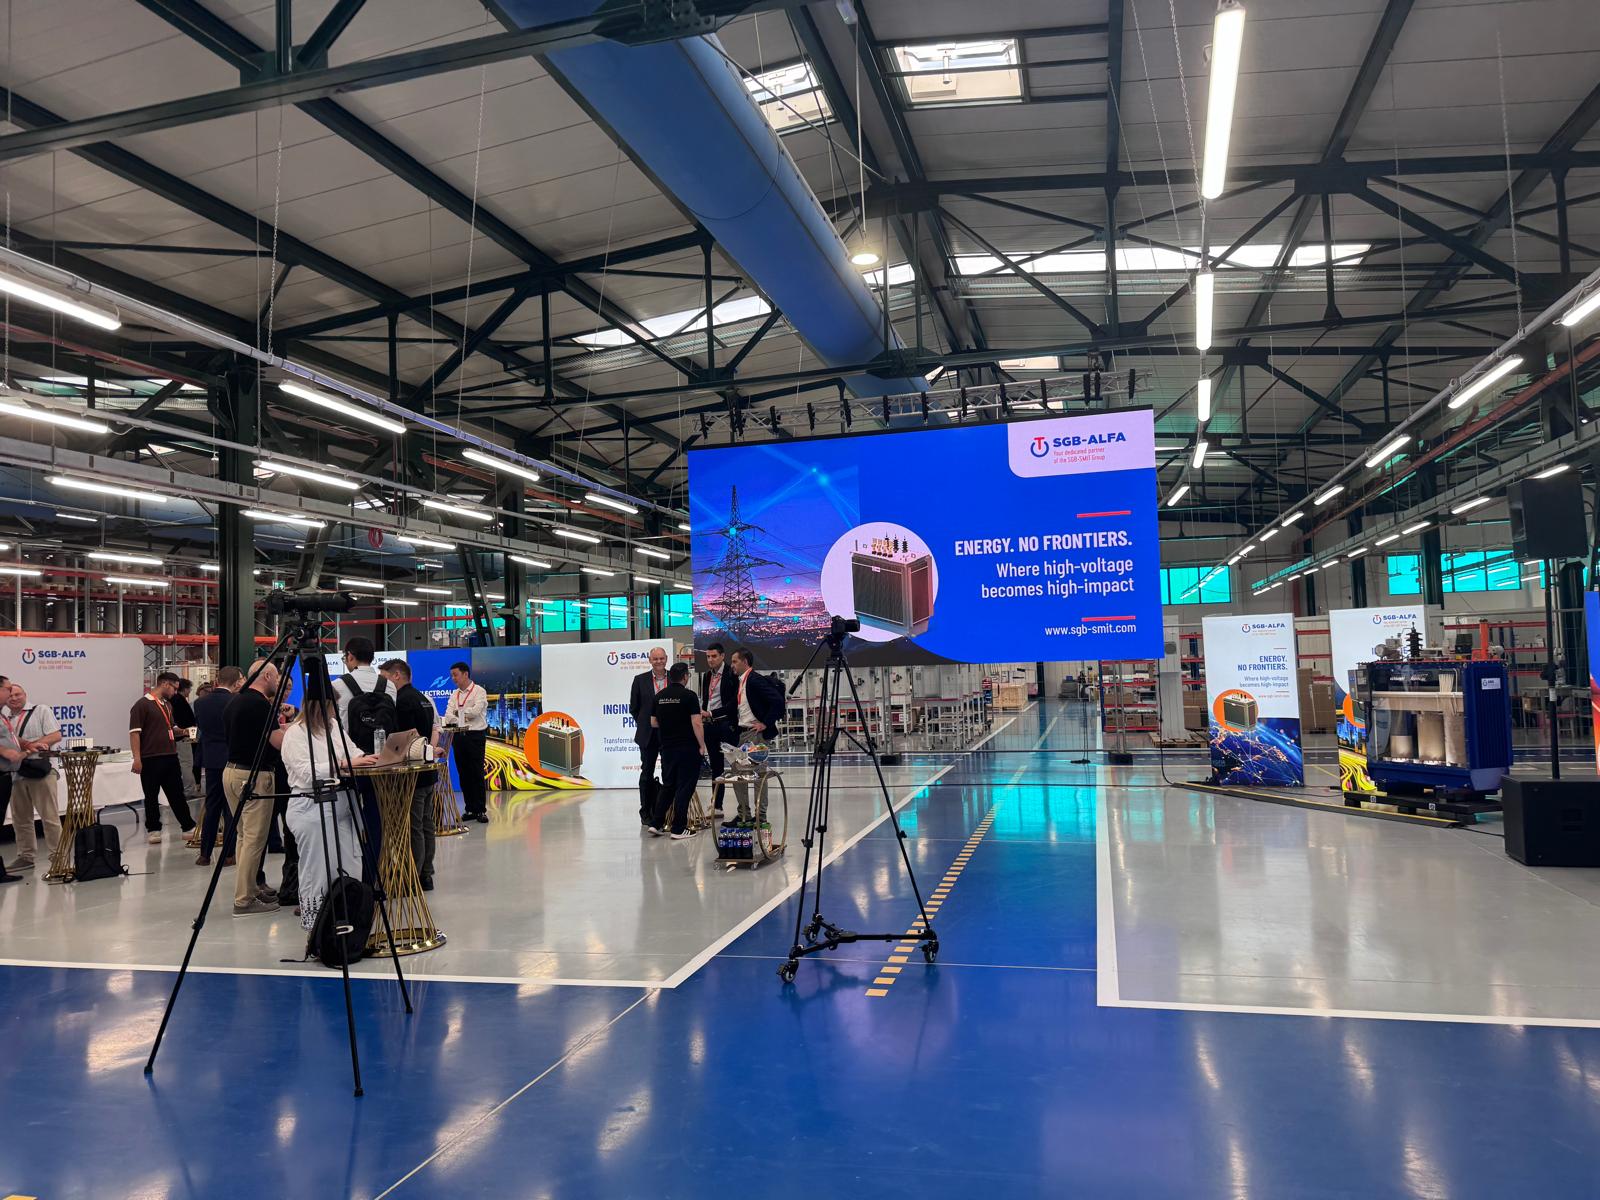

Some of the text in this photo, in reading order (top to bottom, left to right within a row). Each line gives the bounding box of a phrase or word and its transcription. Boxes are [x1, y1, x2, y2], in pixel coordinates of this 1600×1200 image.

[1053, 432, 1126, 447] SGB-ALFA
[1088, 447, 1105, 455] partner
[1092, 454, 1105, 462] Group
[955, 530, 1133, 556] ENERGY. NO FRONTIERS.
[996, 557, 1134, 578] Where high-voltage
[981, 577, 1135, 599] becomes high-impact
[1044, 622, 1137, 637] www.sgb-smit.com
[38, 650, 86, 658] SGB-ALFA
[620, 651, 650, 660] SGB-AL
[1259, 655, 1288, 663] ENERGY.
[1248, 663, 1288, 671] FRONTIERS.
[51, 705, 86, 720] ERGY.
[603, 704, 630, 715] INGIN
[622, 717, 638, 728] PR
